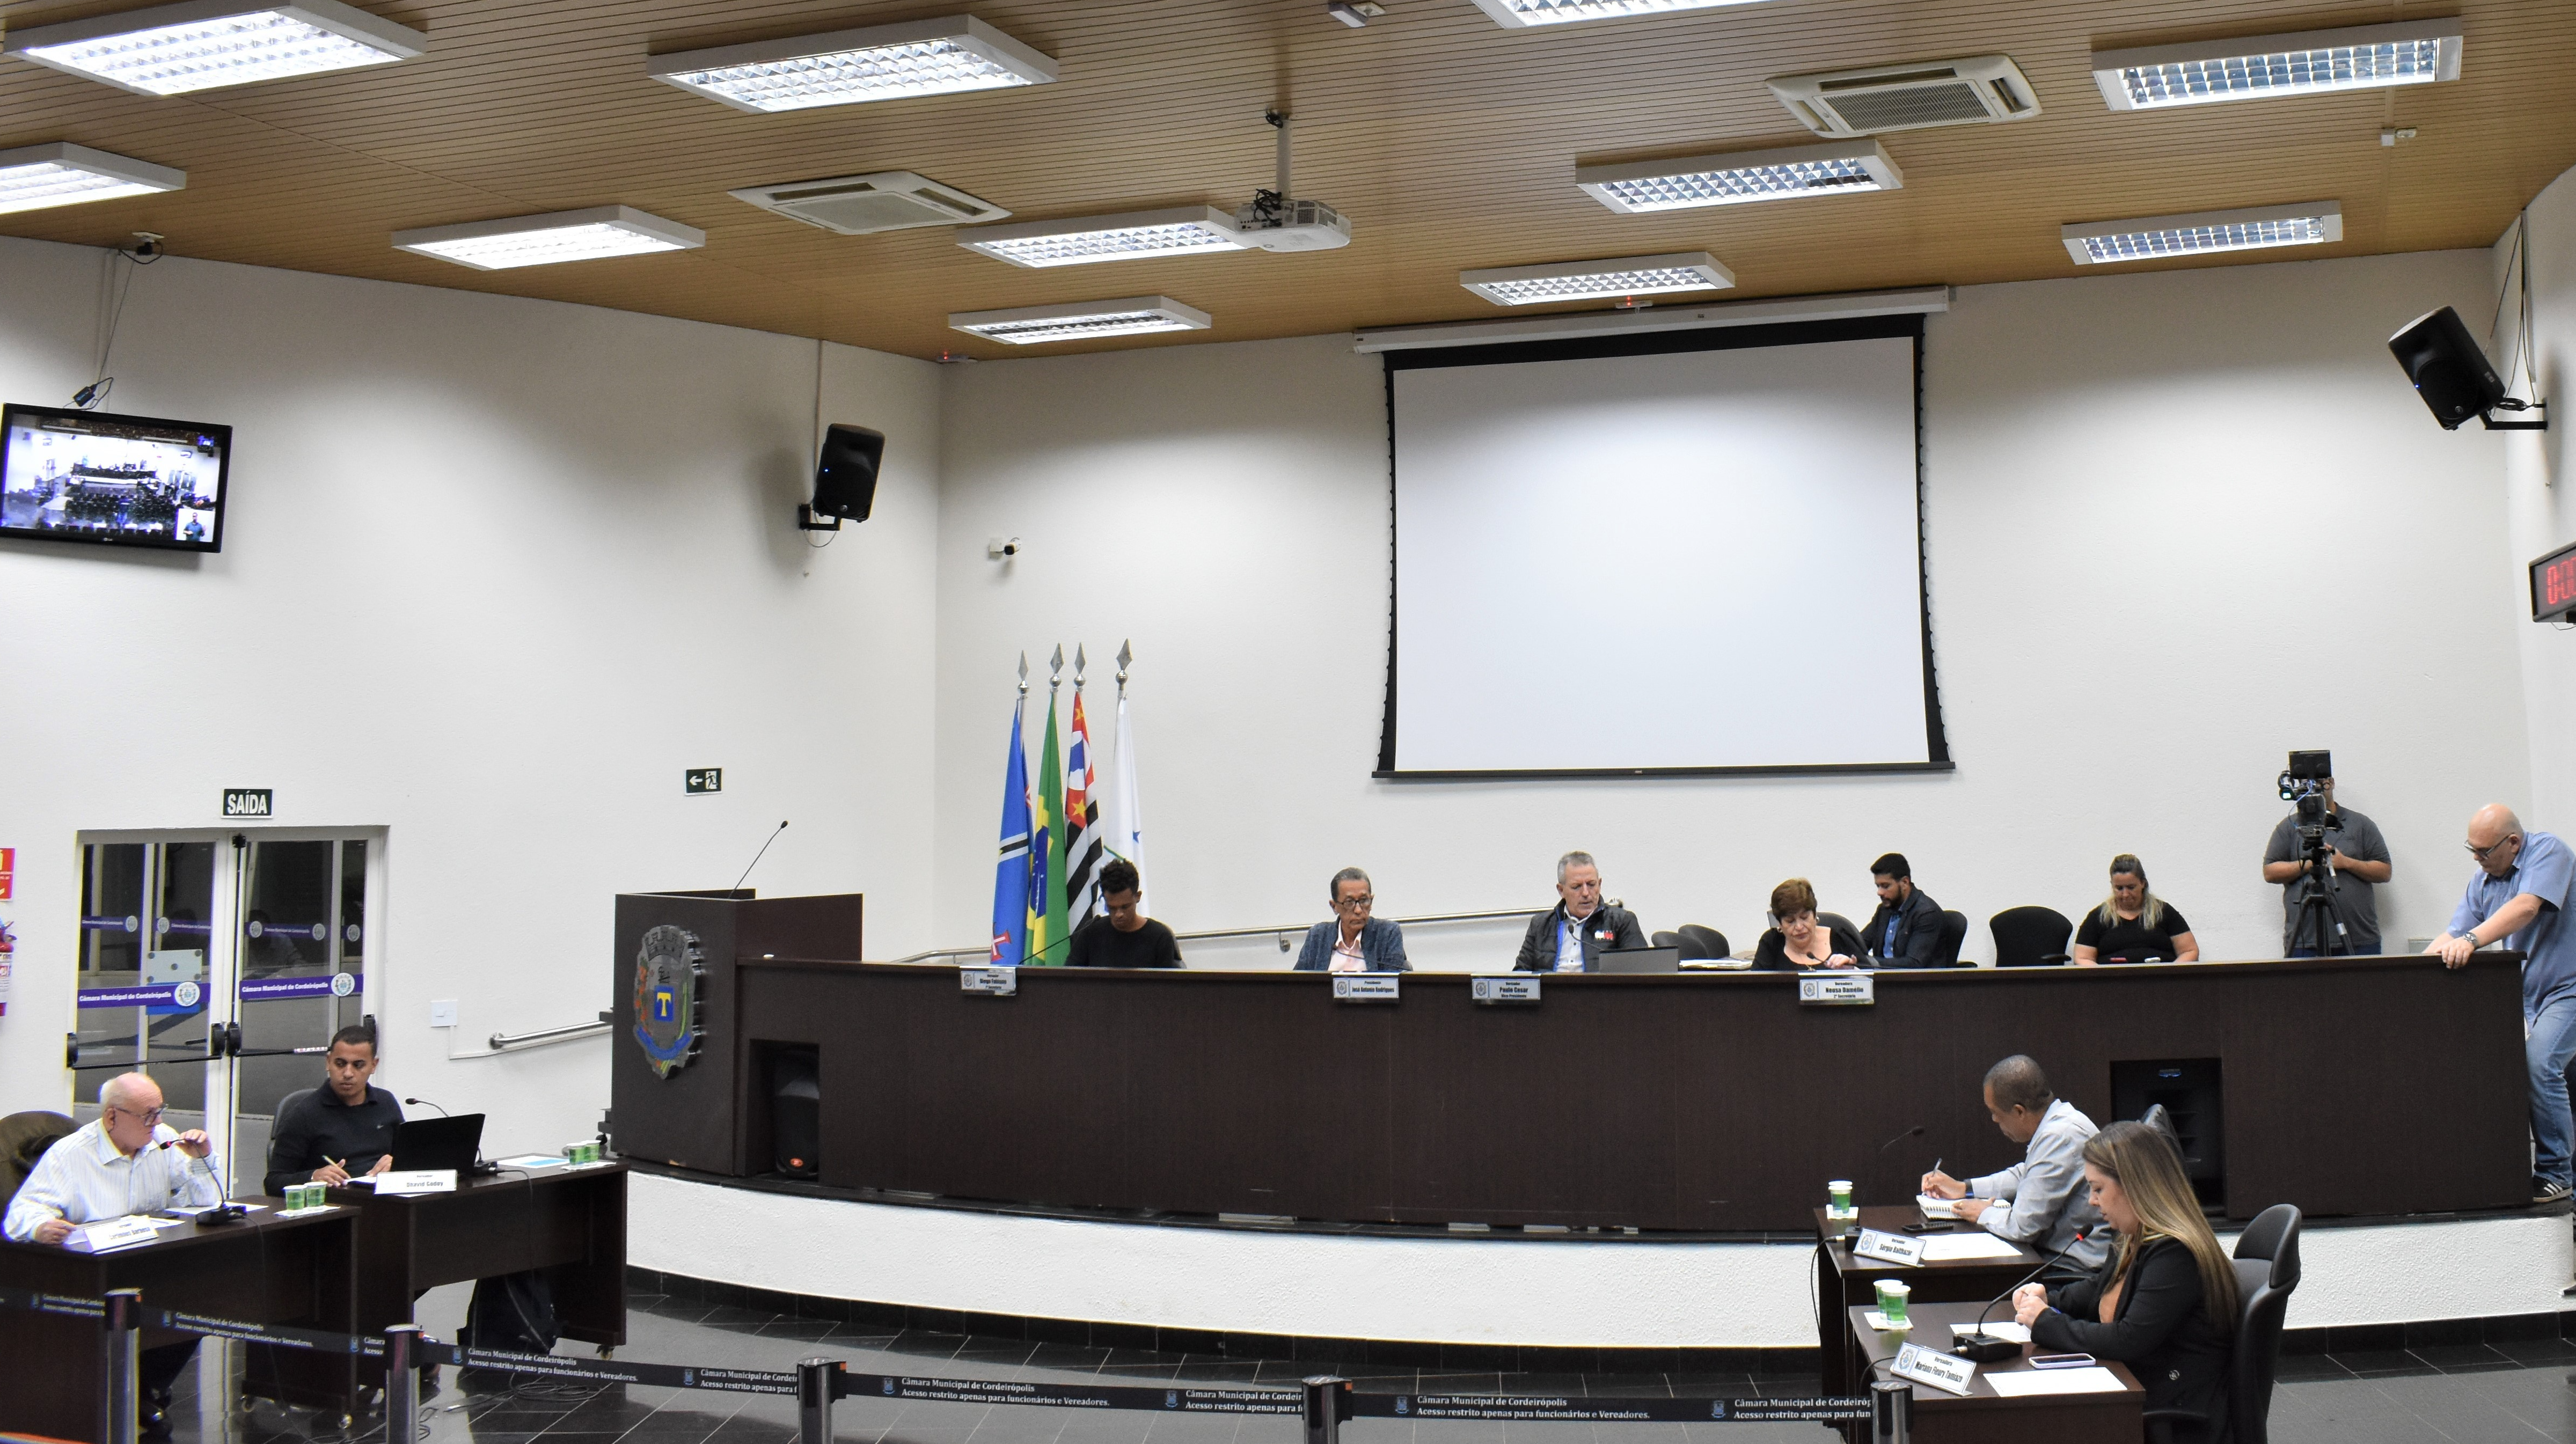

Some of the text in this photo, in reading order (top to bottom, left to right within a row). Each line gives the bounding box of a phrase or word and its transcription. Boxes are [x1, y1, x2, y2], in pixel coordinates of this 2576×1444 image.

[228, 790, 267, 814] SAÍDA
[196, 1315, 221, 1325] Municipal
[468, 1347, 492, 1357] Câmara
[493, 1350, 523, 1361] Municipal
[533, 1355, 576, 1366] Cordeirópolis
[1935, 1356, 1952, 1366] Vereadora
[468, 1358, 489, 1367] Acesso
[490, 1361, 514, 1369] restrito
[554, 1367, 594, 1377] funcionários
[600, 1372, 638, 1381] Vereadores.
[1915, 1361, 1932, 1373] Mariana
[700, 1369, 726, 1377] Câmara
[727, 1370, 761, 1381] Municipal
[700, 1380, 723, 1388] Acesso
[902, 1377, 930, 1386] Câmara
[932, 1380, 969, 1390] Municipal
[982, 1382, 1035, 1393] Cordeirópolis
[902, 1389, 927, 1397] Acesso
[929, 1391, 957, 1399] restrito
[959, 1393, 986, 1401] apenas
[1007, 1395, 1056, 1404] funcionários
[1063, 1397, 1110, 1406] Vereadores.
[1185, 1390, 1216, 1398] Câmara
[1218, 1391, 1258, 1401] Municipal
[1185, 1401, 1212, 1409] Acesso
[1214, 1403, 1245, 1411] restrito
[1247, 1404, 1275, 1412] apenas
[1417, 1396, 1449, 1404] Câmara
[1452, 1397, 1494, 1406] Municipal
[1508, 1398, 1567, 1408] Cordeirópolis
[1735, 1399, 1768, 1407] Câmara
[1770, 1399, 1813, 1408] Municipal
[1417, 1408, 1445, 1416] Acesso
[1482, 1410, 1512, 1418] apenas
[1536, 1410, 1590, 1418] funcionários
[1599, 1410, 1650, 1419] Vereadores.
[1734, 1411, 1763, 1419] Acesso
[1766, 1410, 1799, 1418] restrito
[1801, 1411, 1832, 1419] apenas
[1834, 1411, 1854, 1419] para
